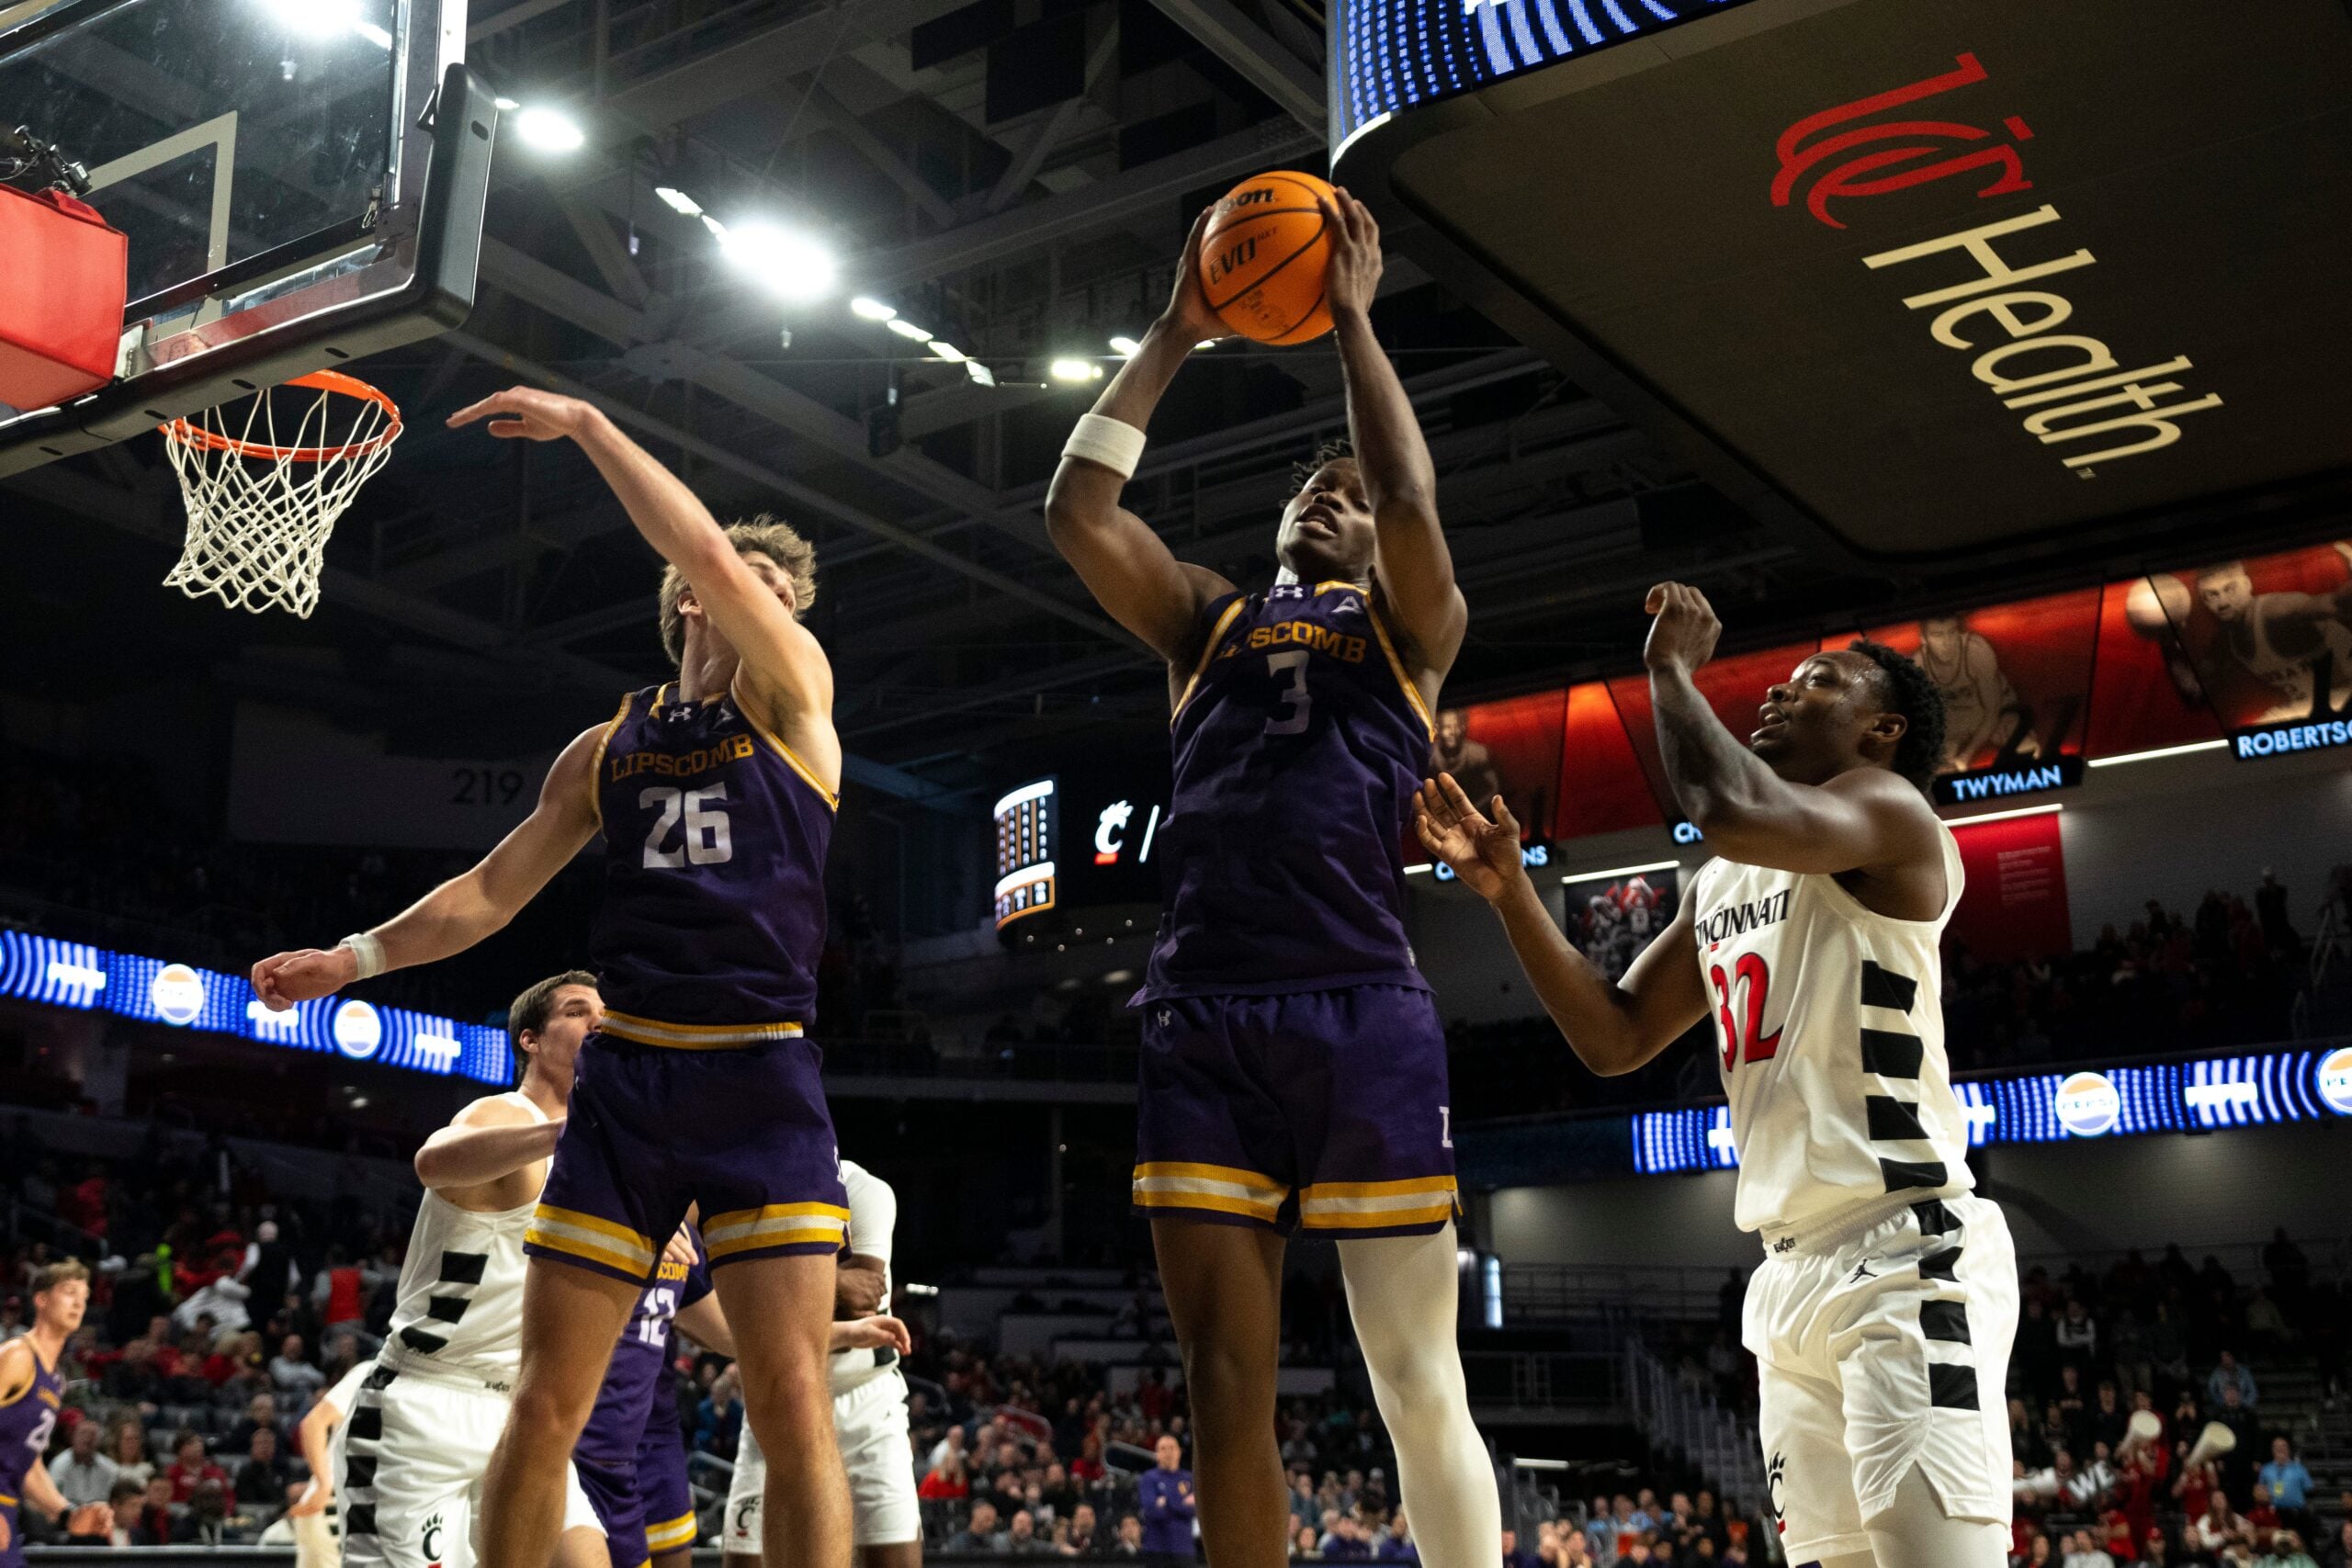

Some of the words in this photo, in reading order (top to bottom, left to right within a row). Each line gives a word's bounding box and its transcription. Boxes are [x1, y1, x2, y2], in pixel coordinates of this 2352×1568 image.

[1861, 204, 2223, 468] Health
[1264, 649, 1313, 735] 3
[611, 734, 755, 782] LIPSCOMB
[2237, 720, 2352, 759] ROBERTS
[453, 768, 523, 806] 219
[1951, 765, 2063, 801] TWYMAN
[639, 782, 733, 869] 26
[1696, 889, 1791, 951] INCINNATI
[1711, 952, 1785, 1073] 32
[639, 1287, 676, 1348] 12
